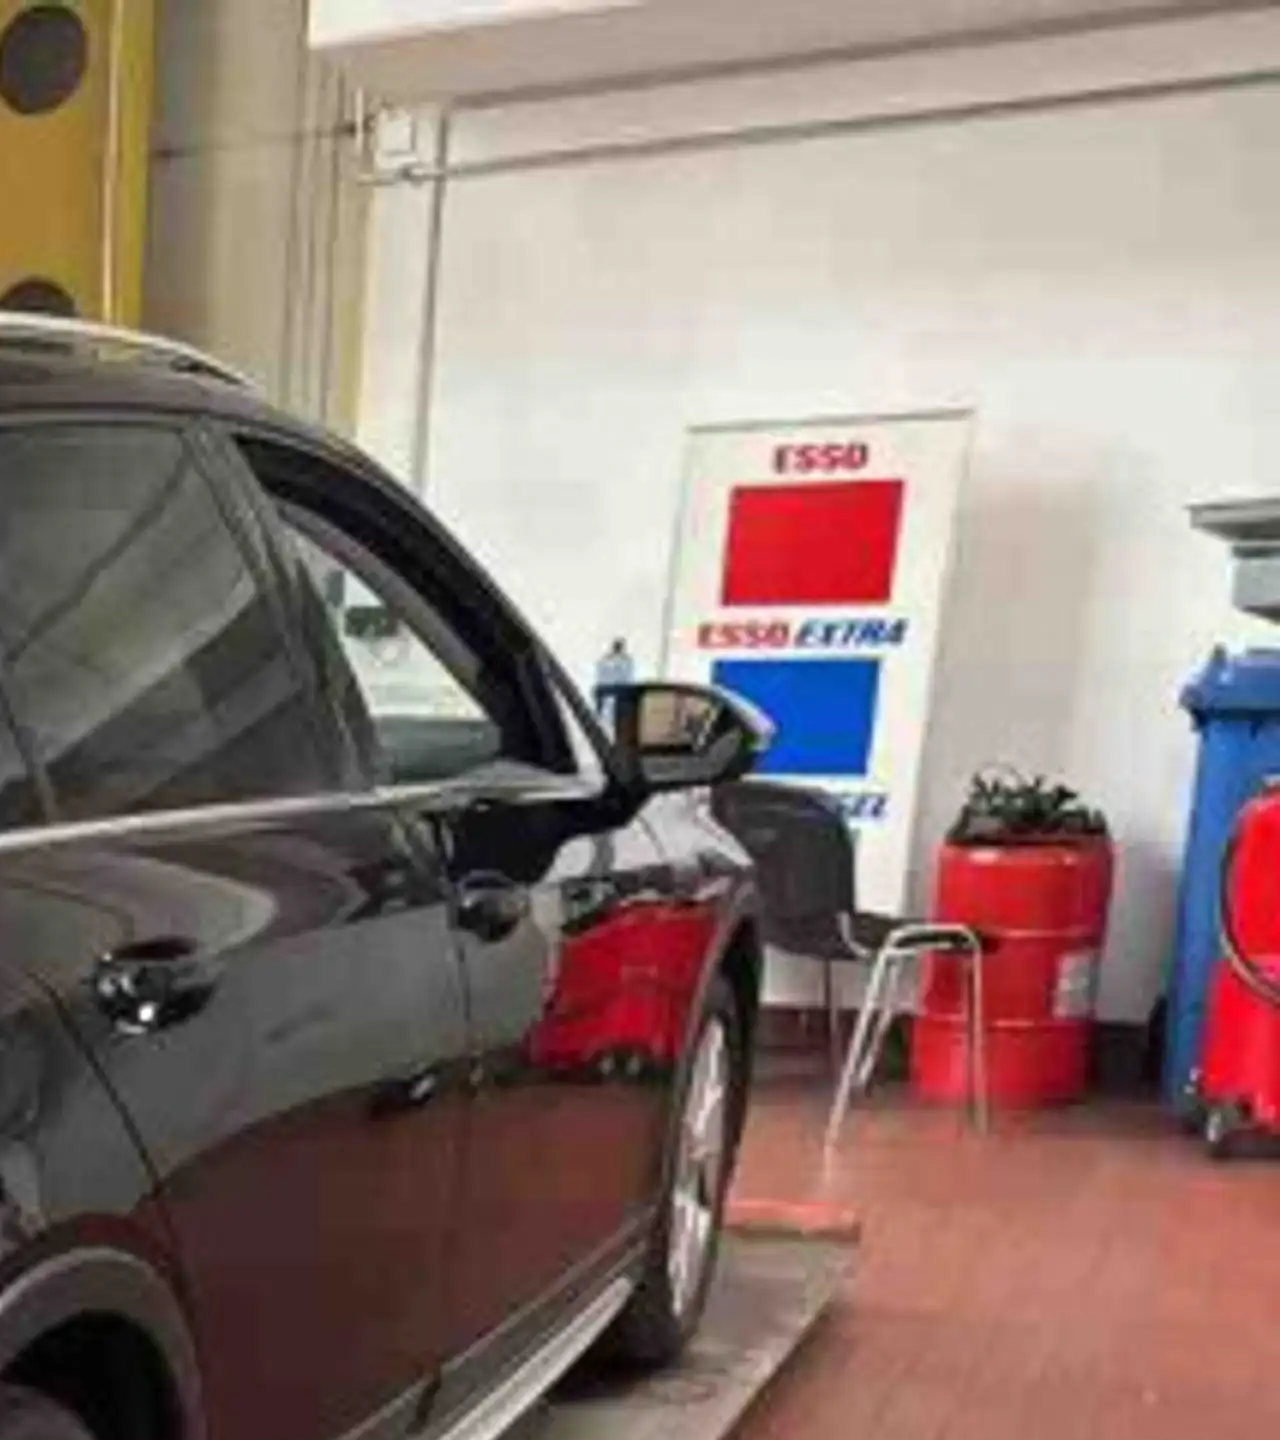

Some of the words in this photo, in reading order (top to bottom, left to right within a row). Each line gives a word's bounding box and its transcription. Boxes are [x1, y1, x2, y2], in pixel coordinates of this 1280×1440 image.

[773, 442, 868, 474] ESSO
[697, 619, 790, 649] ESSO
[793, 617, 908, 648] EXTRA
